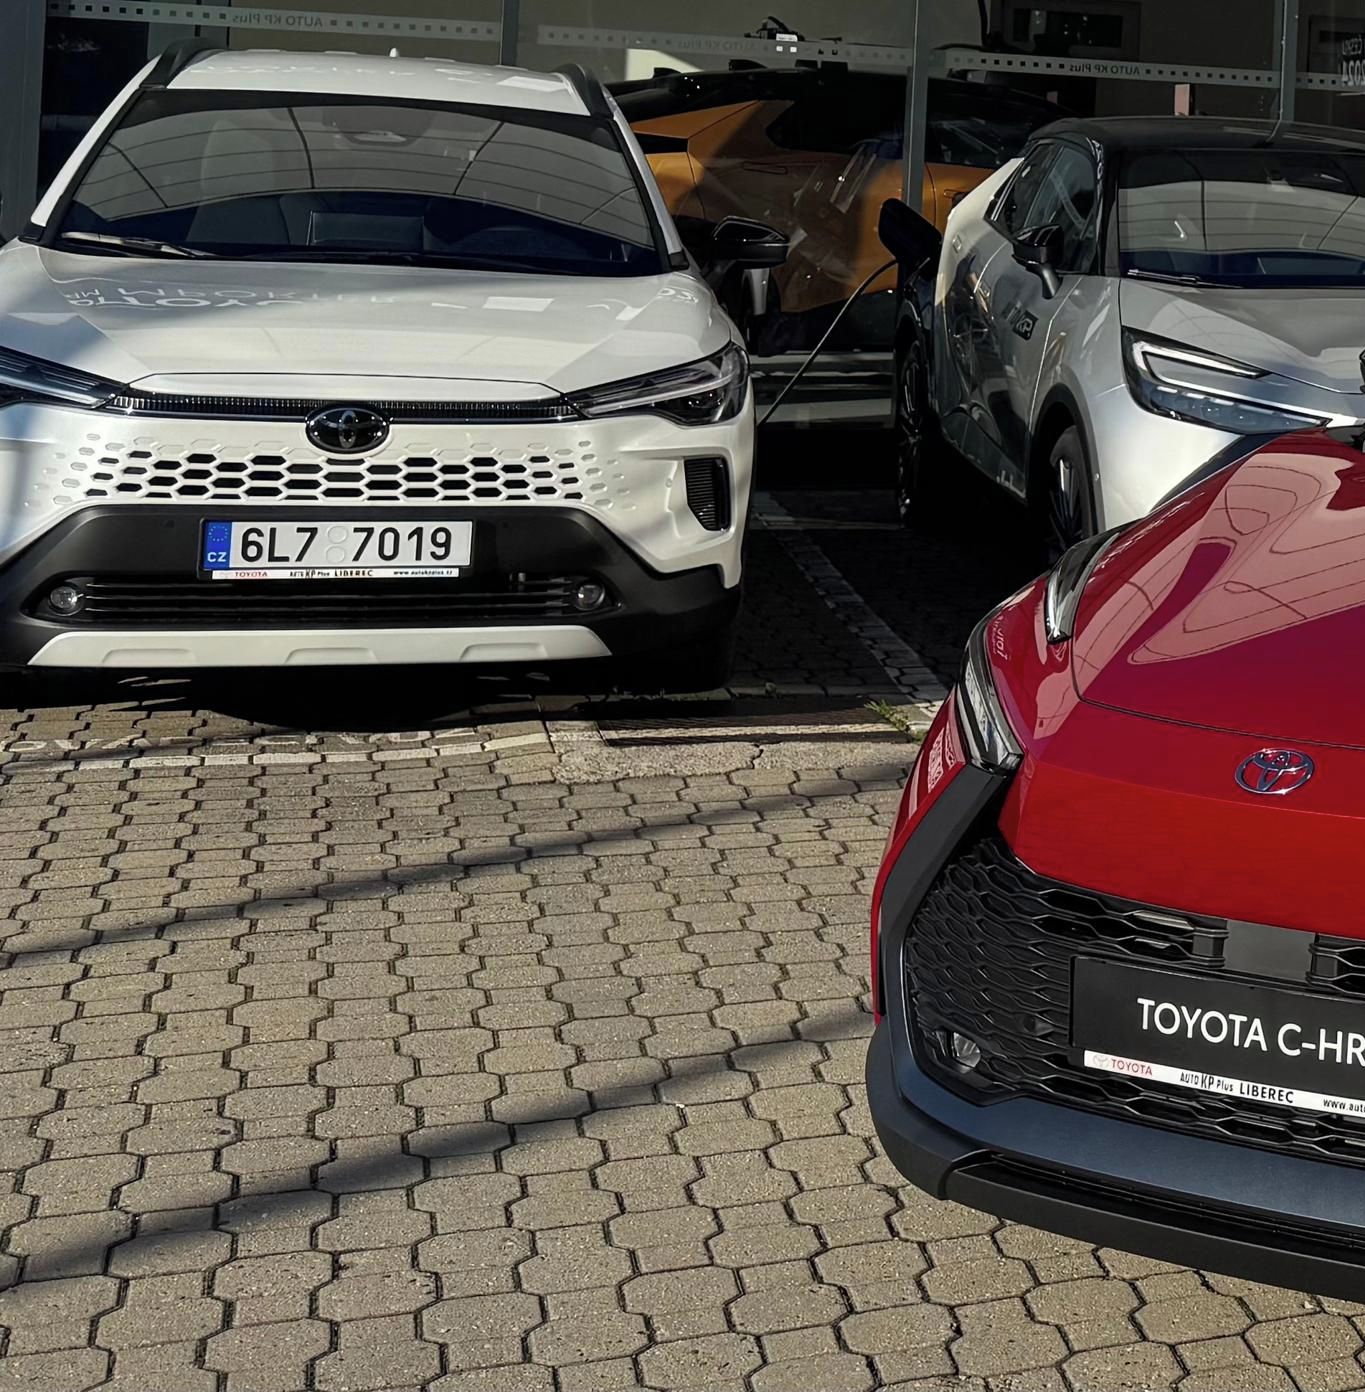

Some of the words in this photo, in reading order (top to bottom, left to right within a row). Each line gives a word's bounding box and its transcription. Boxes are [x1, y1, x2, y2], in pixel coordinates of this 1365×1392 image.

[207, 552, 227, 562] CZ
[241, 527, 318, 563] 6L7
[351, 526, 452, 563] 7019
[1137, 997, 1268, 1051] TOYOTA
[1111, 1058, 1153, 1076] TOYOTA
[1201, 1073, 1215, 1089] KP
[1216, 1079, 1234, 1092] Plus
[1239, 1082, 1294, 1104] LIBEREC
